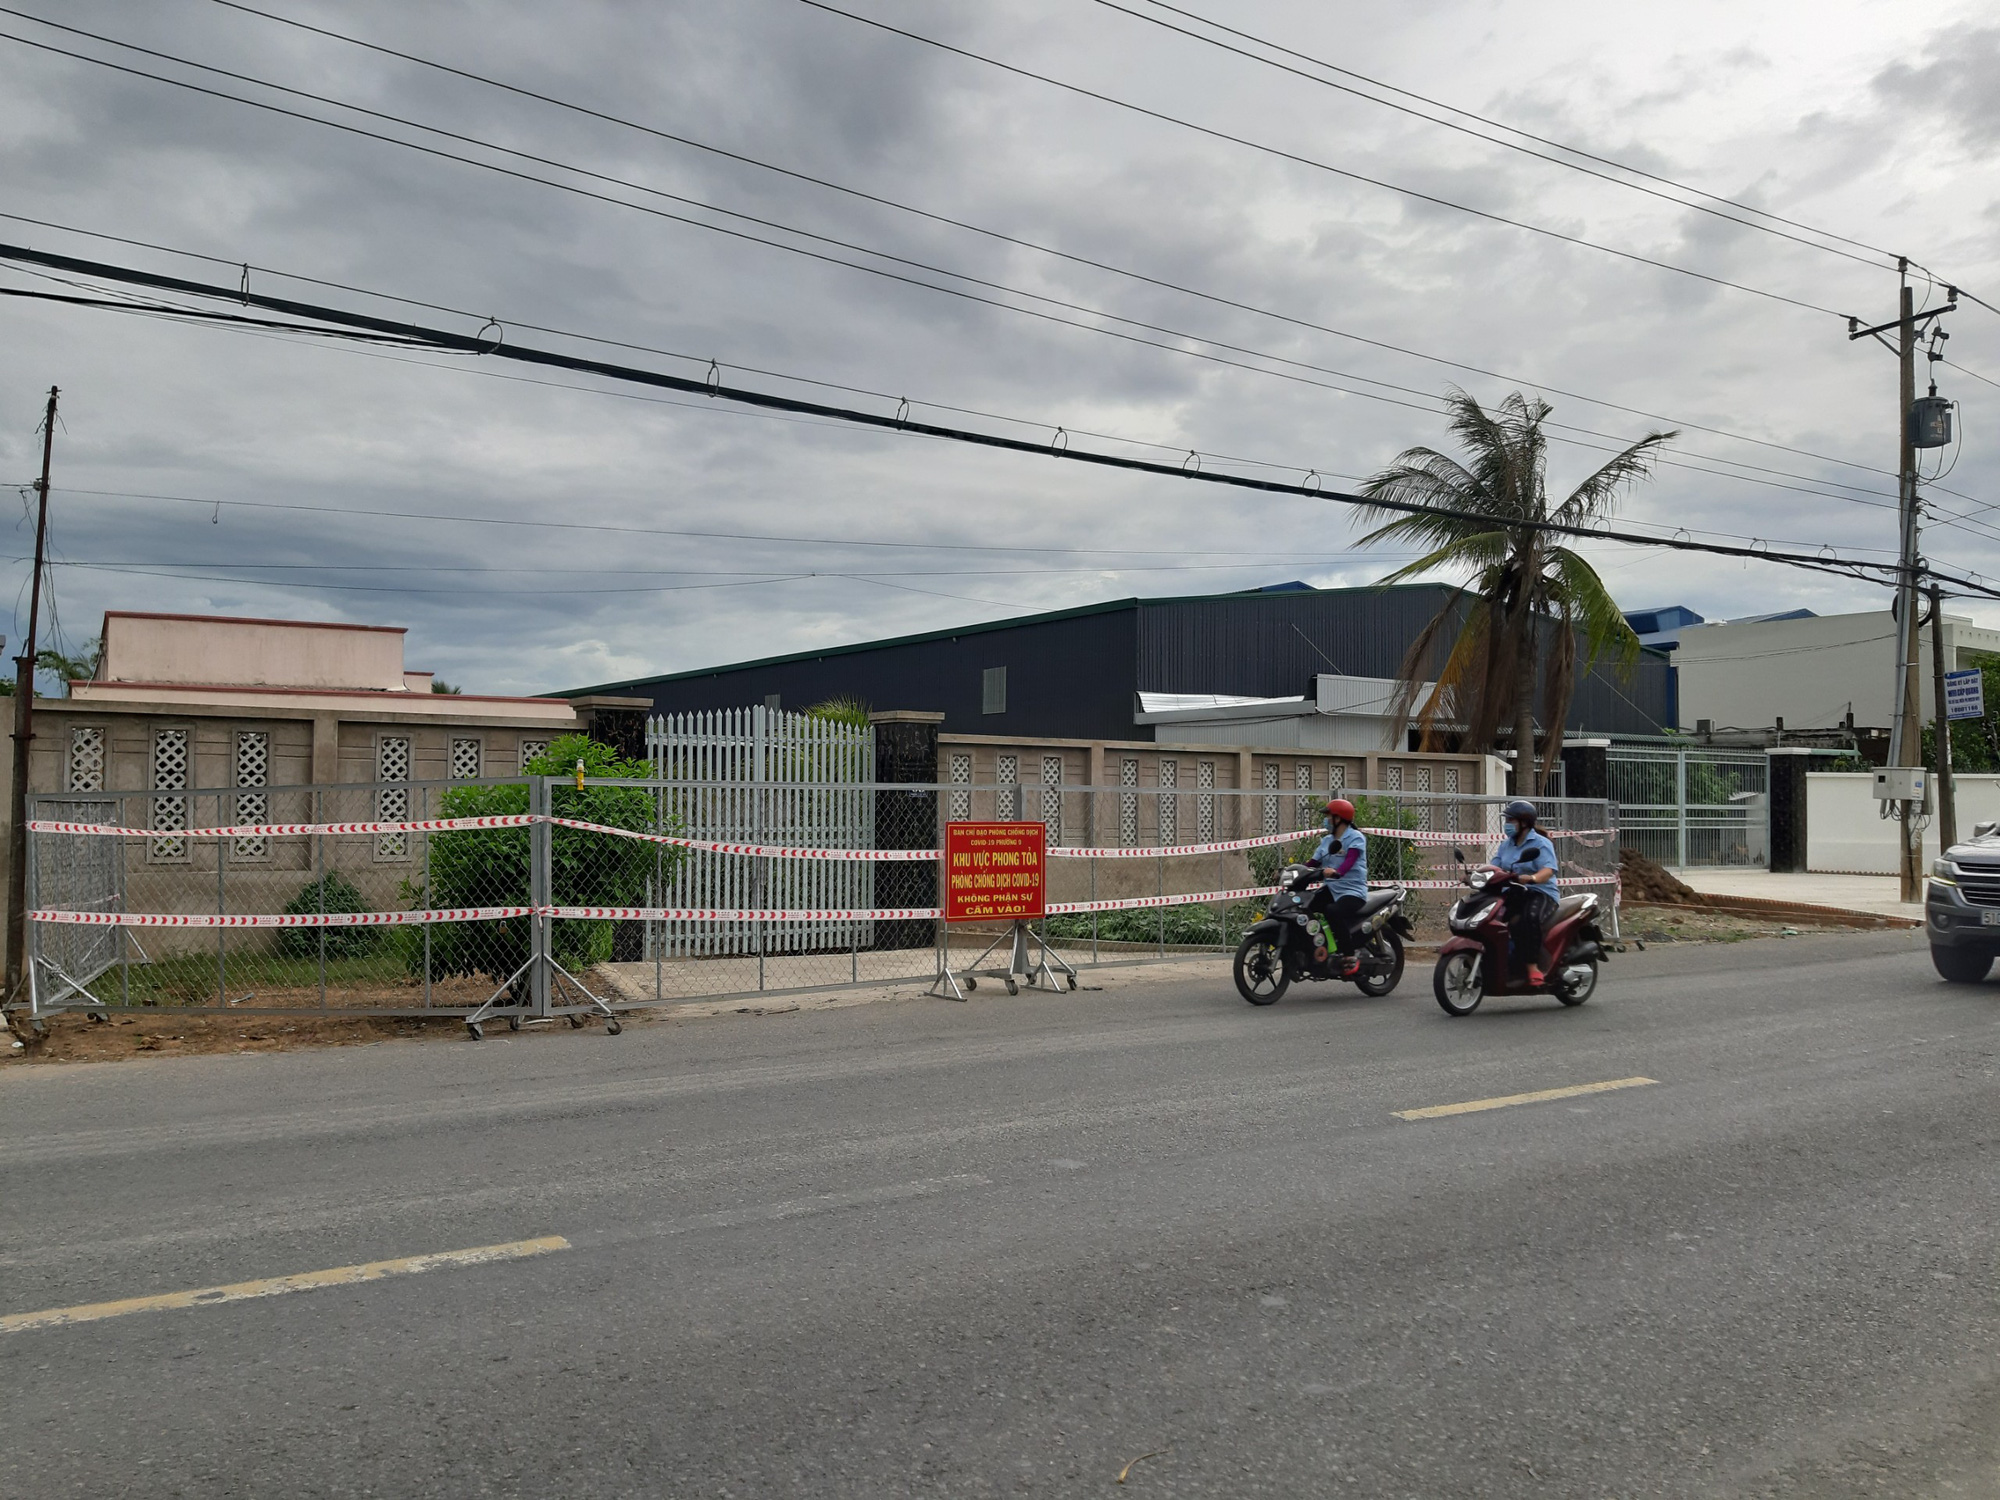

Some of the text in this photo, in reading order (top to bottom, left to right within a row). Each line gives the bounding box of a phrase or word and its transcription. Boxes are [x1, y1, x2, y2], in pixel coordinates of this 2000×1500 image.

[1008, 827, 1025, 836] CHỐNG
[1026, 828, 1038, 836] DỊCH
[953, 846, 1038, 869] KHU VỰC PHONG TỎA
[952, 868, 1040, 890] PHÒNG CHỐNG DỊCH COVID-19
[958, 892, 1033, 902] KHÔNG PHẬN SỰ
[966, 904, 1026, 914] CẤM VÀO!
